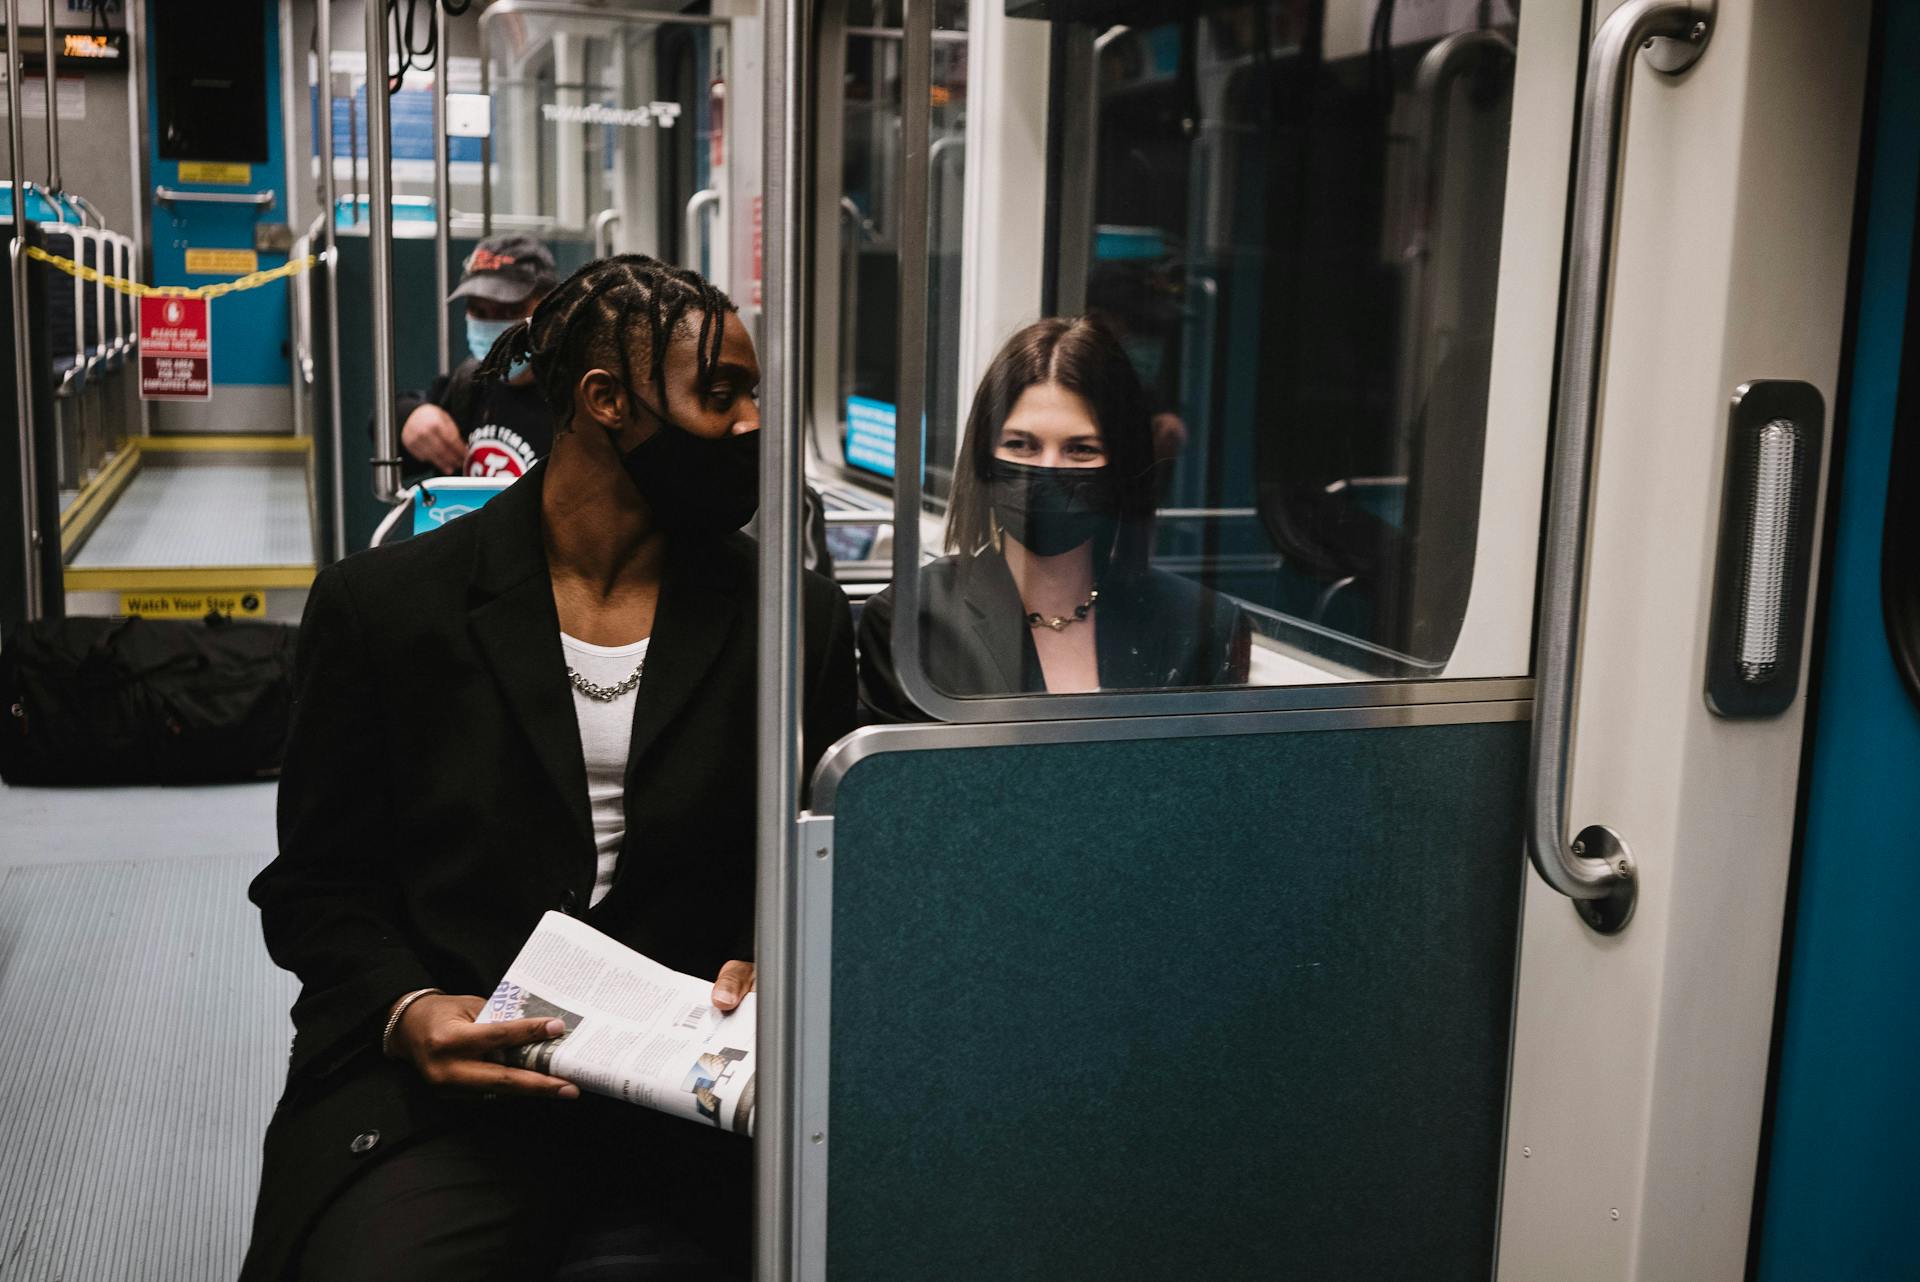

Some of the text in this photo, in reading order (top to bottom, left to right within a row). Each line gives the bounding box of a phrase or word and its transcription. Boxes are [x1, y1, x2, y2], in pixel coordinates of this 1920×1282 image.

[128, 597, 236, 613] Watch Your Step
